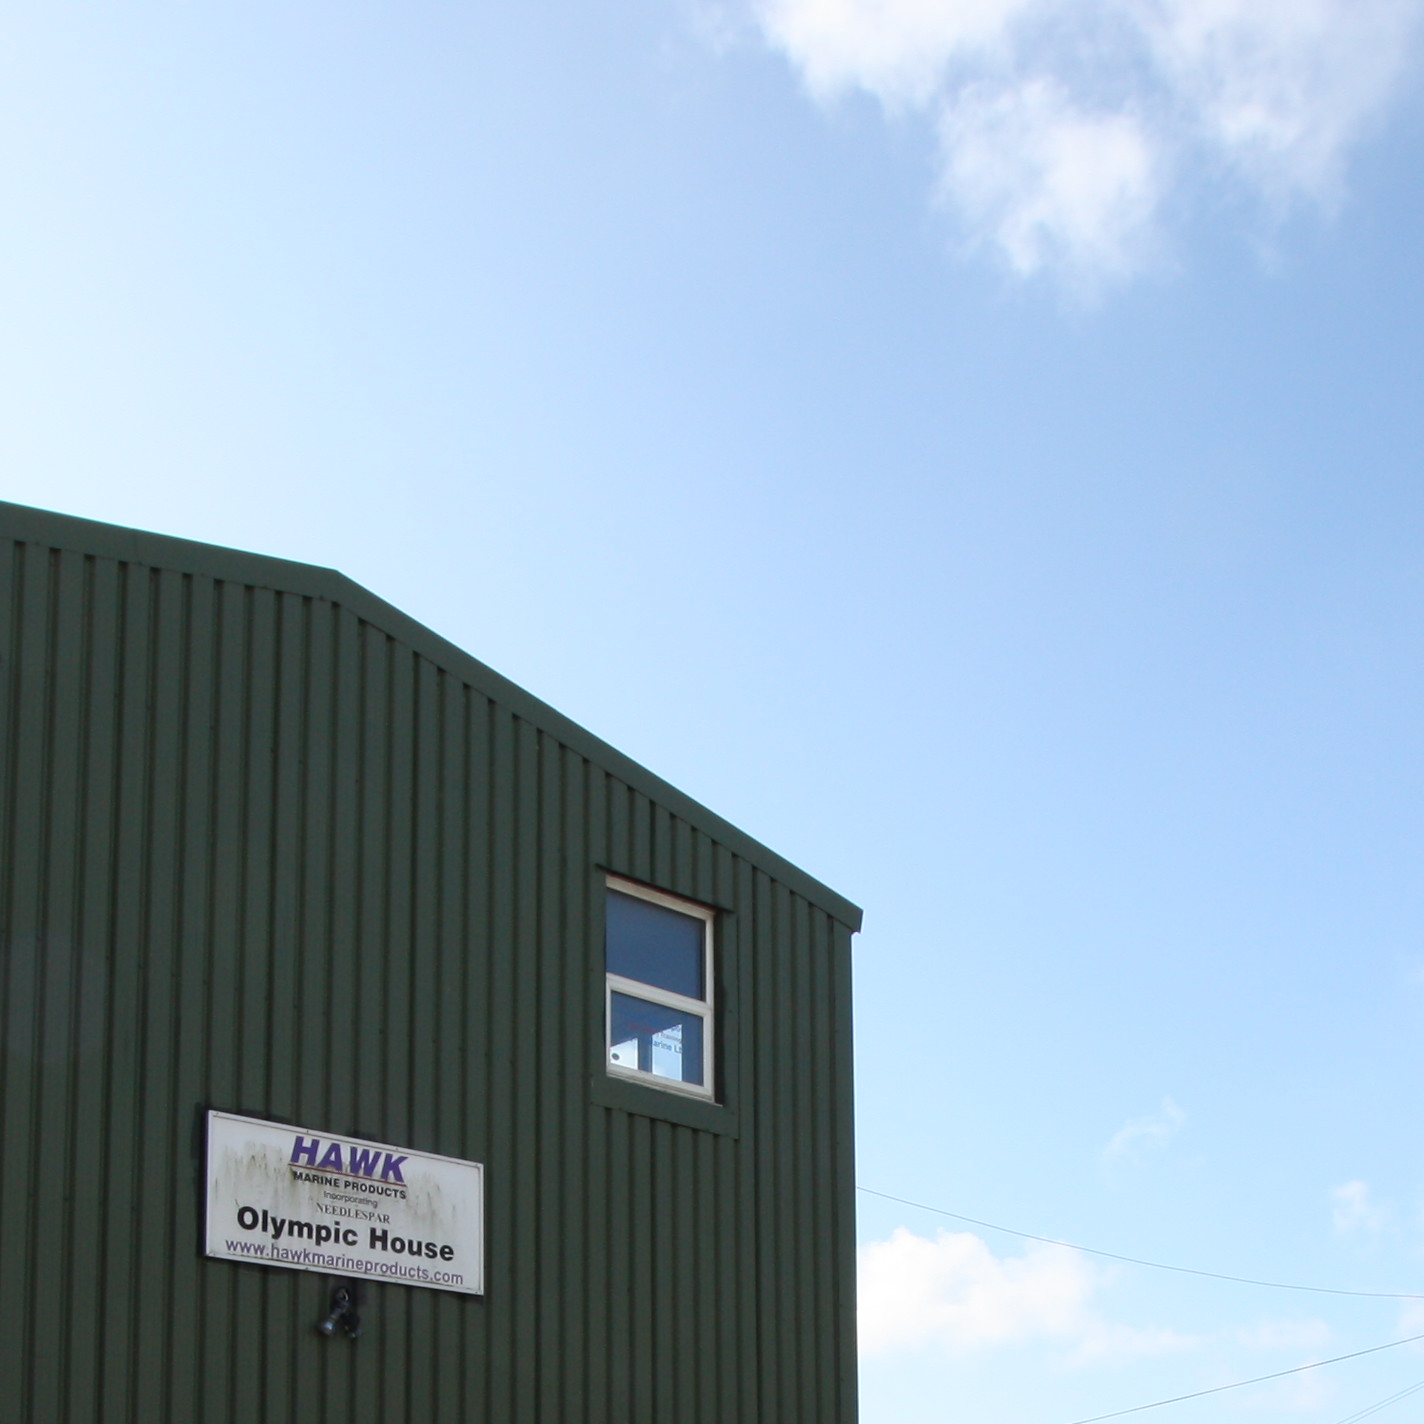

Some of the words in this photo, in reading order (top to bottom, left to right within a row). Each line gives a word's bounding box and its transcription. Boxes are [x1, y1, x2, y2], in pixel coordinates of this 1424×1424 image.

[290, 1136, 408, 1183] HAWK
[293, 1170, 340, 1188] MARINE
[344, 1180, 407, 1200] PRODUCTS
[323, 1190, 378, 1209] Incorporating
[316, 1202, 391, 1224] NEEDLESPAR
[236, 1206, 358, 1247] Olympic
[369, 1227, 454, 1262] House
[225, 1239, 464, 1286] www.hawkmarineproducts.com
